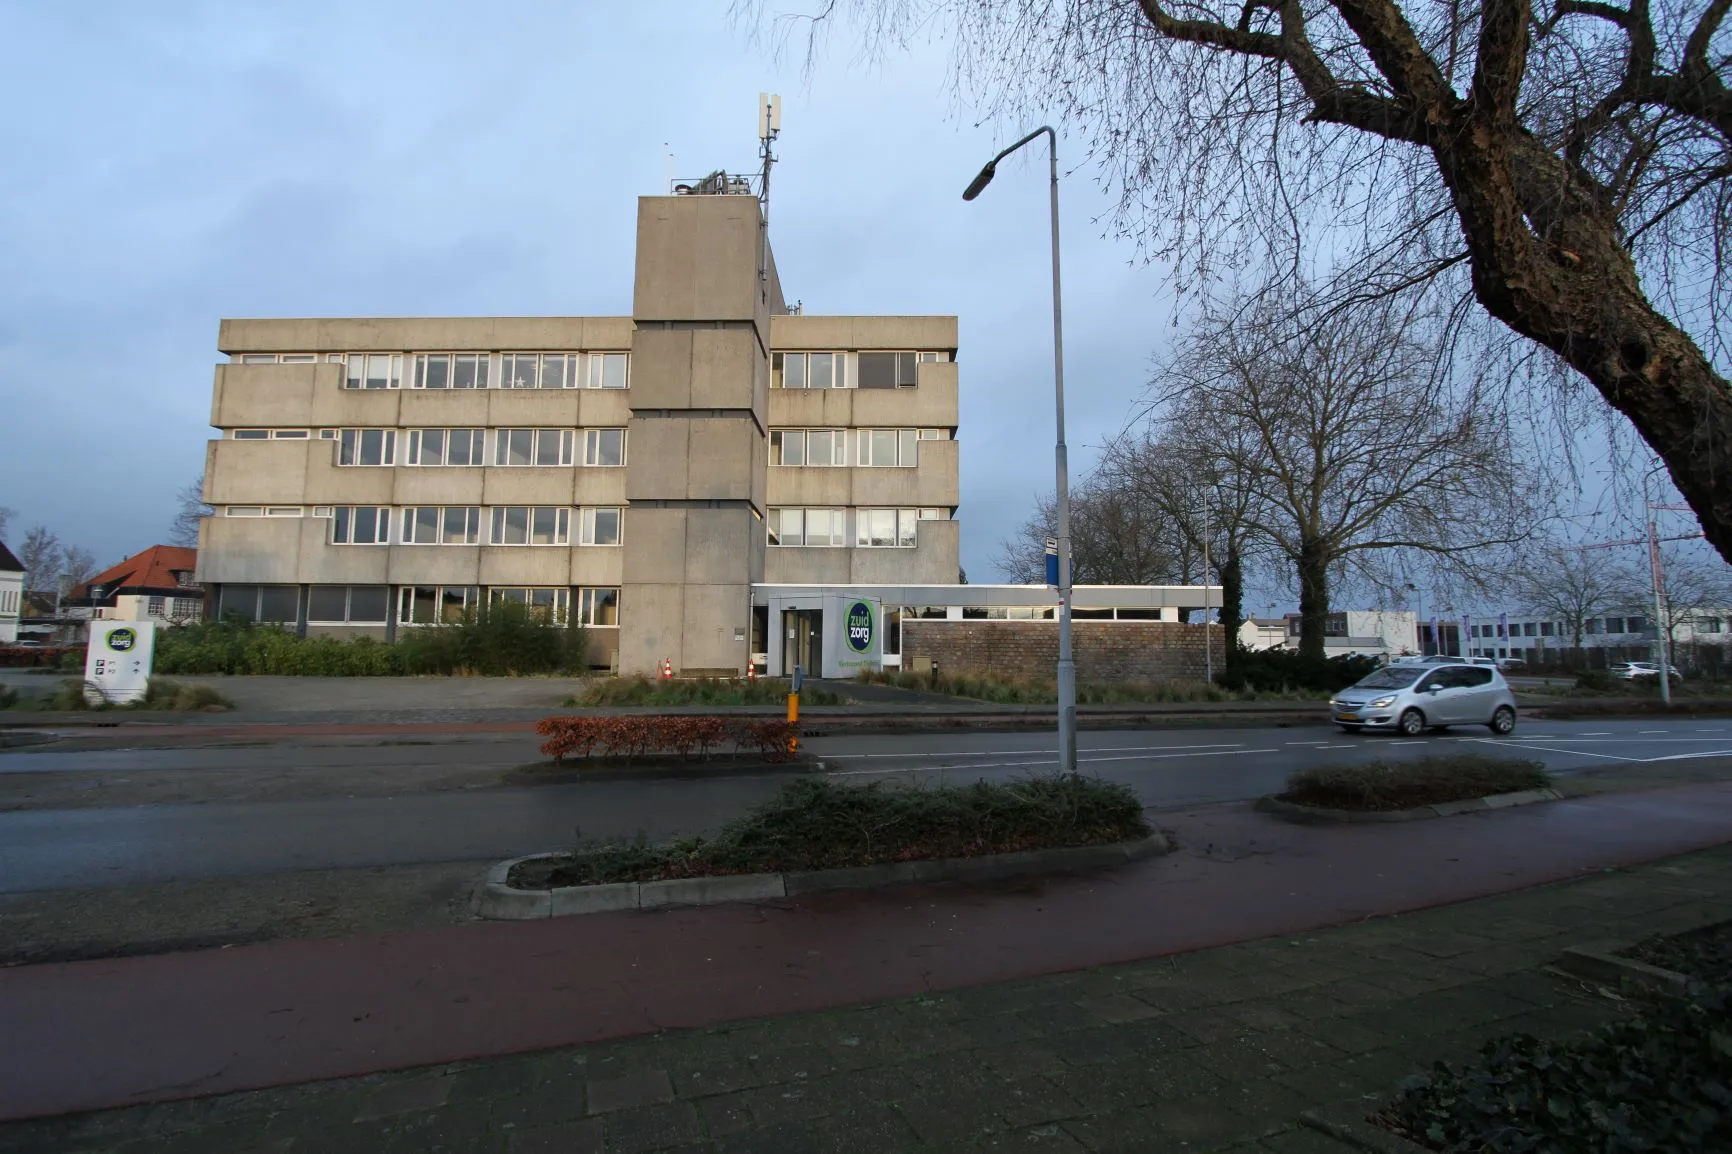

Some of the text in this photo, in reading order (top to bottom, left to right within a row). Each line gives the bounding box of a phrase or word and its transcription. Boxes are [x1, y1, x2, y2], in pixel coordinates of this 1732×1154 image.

[850, 610, 869, 627] zuid
[850, 627, 869, 643] zorg
[111, 640, 131, 648] zorg
